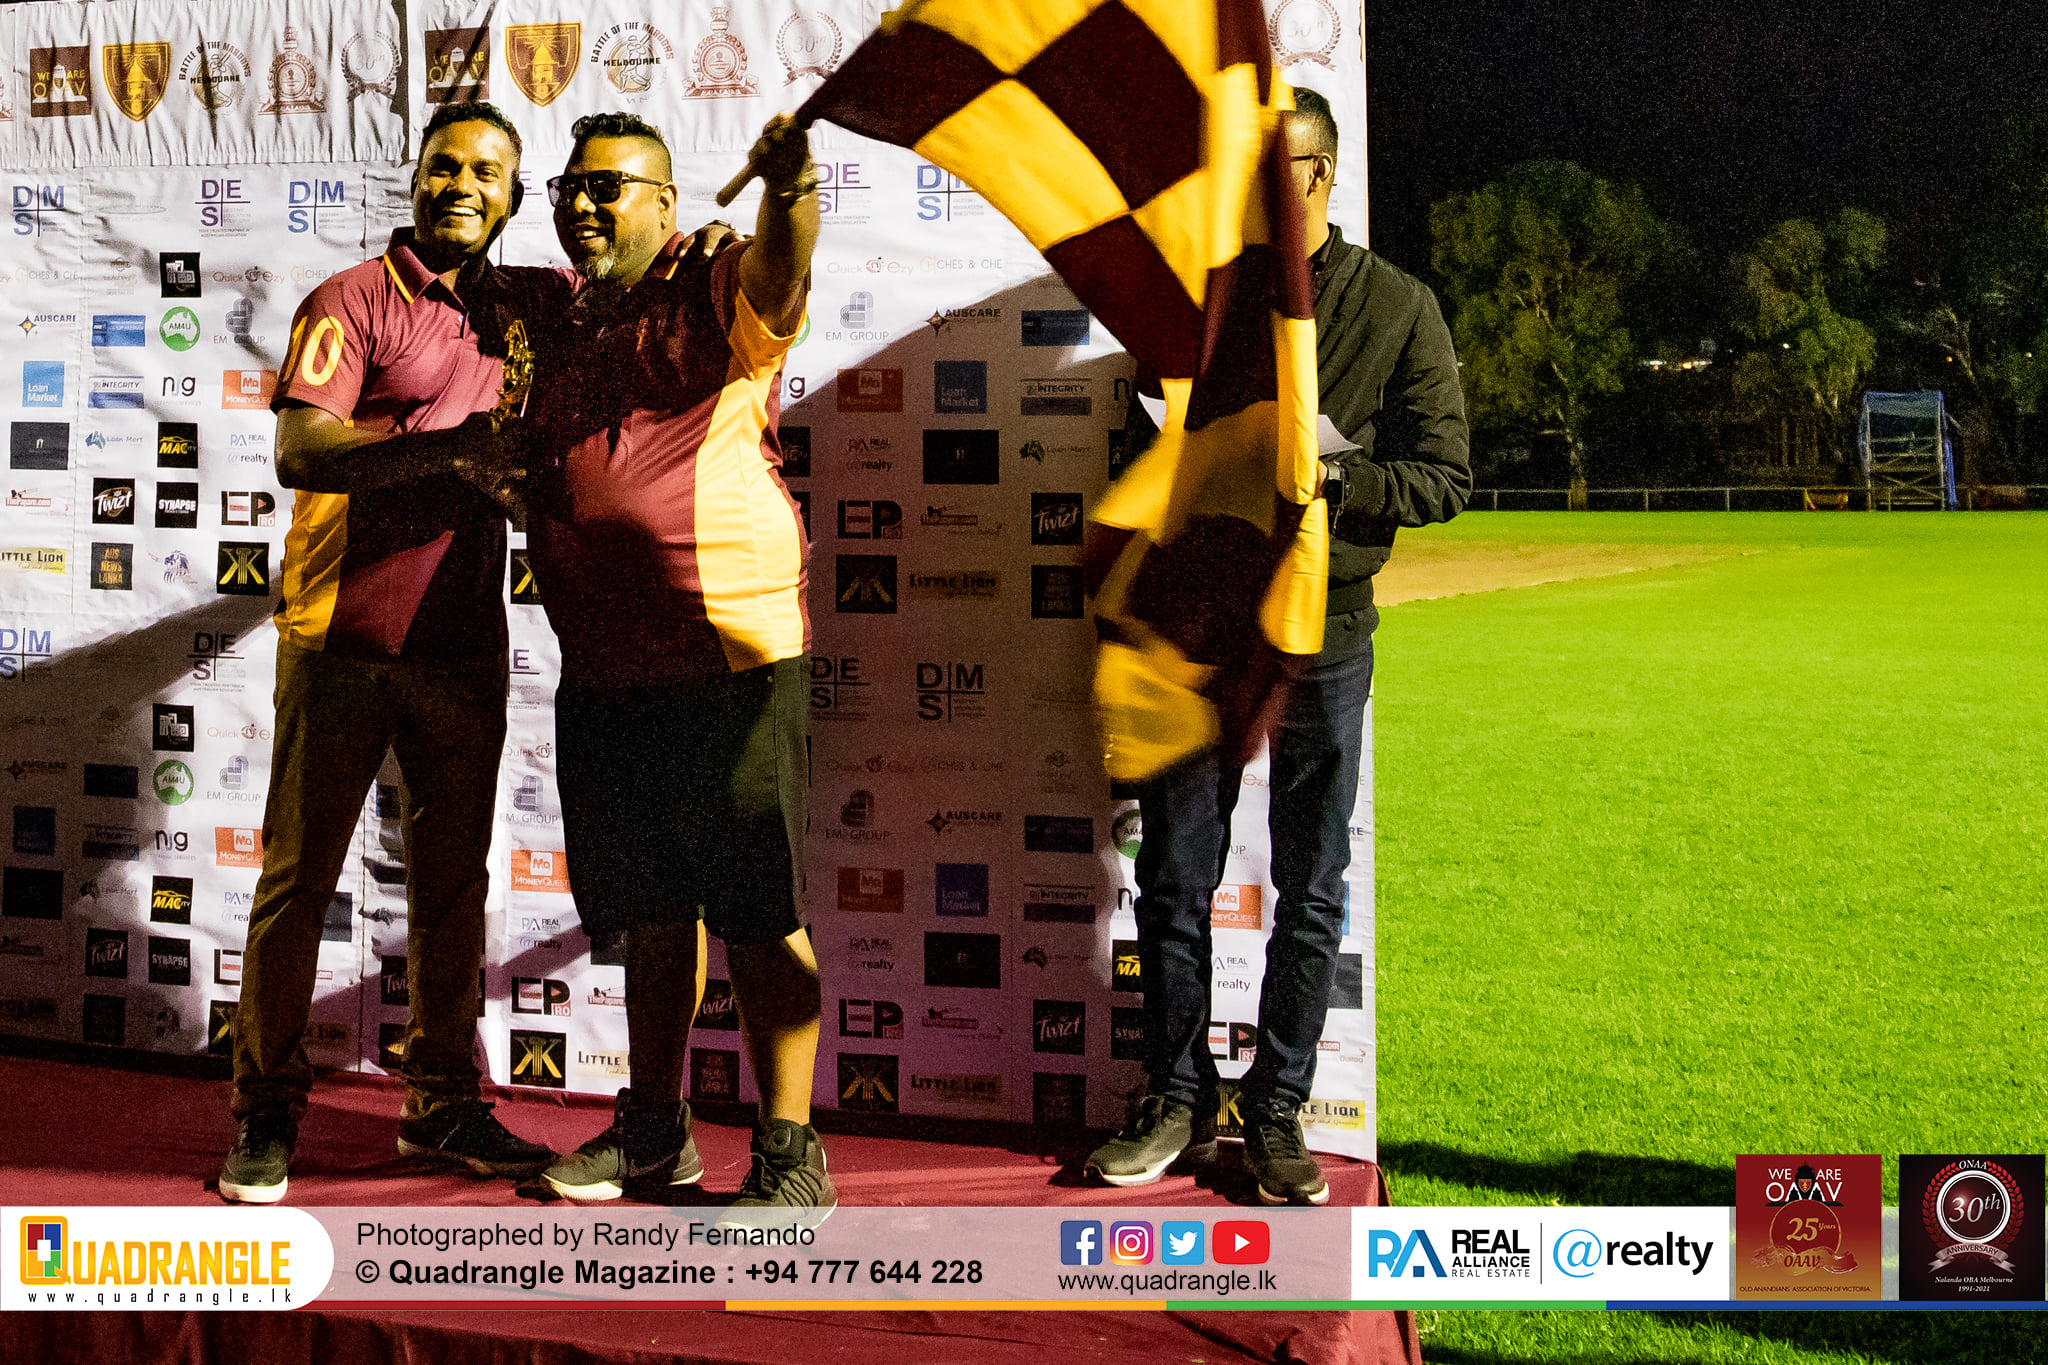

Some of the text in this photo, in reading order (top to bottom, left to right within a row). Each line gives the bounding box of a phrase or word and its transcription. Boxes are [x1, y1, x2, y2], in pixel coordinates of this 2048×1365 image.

[591, 21, 674, 63] BATTLE OF THE MAROONS
[178, 50, 196, 81] BATTLE
[207, 41, 221, 50] THE
[603, 56, 661, 67] MELBOURNE
[917, 195, 942, 221] S
[200, 206, 219, 227] S
[287, 209, 309, 234] S
[13, 212, 34, 236] S
[945, 309, 1001, 318] AUSCARE
[169, 322, 191, 331] AM4U
[849, 331, 889, 341] GROUP
[27, 383, 48, 392] Loan
[102, 381, 140, 389] INTEGRITY
[1037, 384, 1085, 393] INTEGRITY
[27, 393, 58, 402] Market
[158, 498, 196, 512] SYNAPSE
[0, 550, 32, 562] ITTLE
[101, 561, 122, 572] NEWS
[810, 685, 833, 709] S
[917, 695, 943, 721] S
[162, 775, 185, 785] AM4U
[227, 792, 261, 802] GROUP
[522, 814, 558, 825] GROUP
[945, 811, 1001, 821] AUSCARE
[1041, 890, 1089, 901] INTEGRITY
[1227, 957, 1248, 966] REAL
[578, 1050, 621, 1066] LITTLE
[1325, 1102, 1359, 1117] LION
